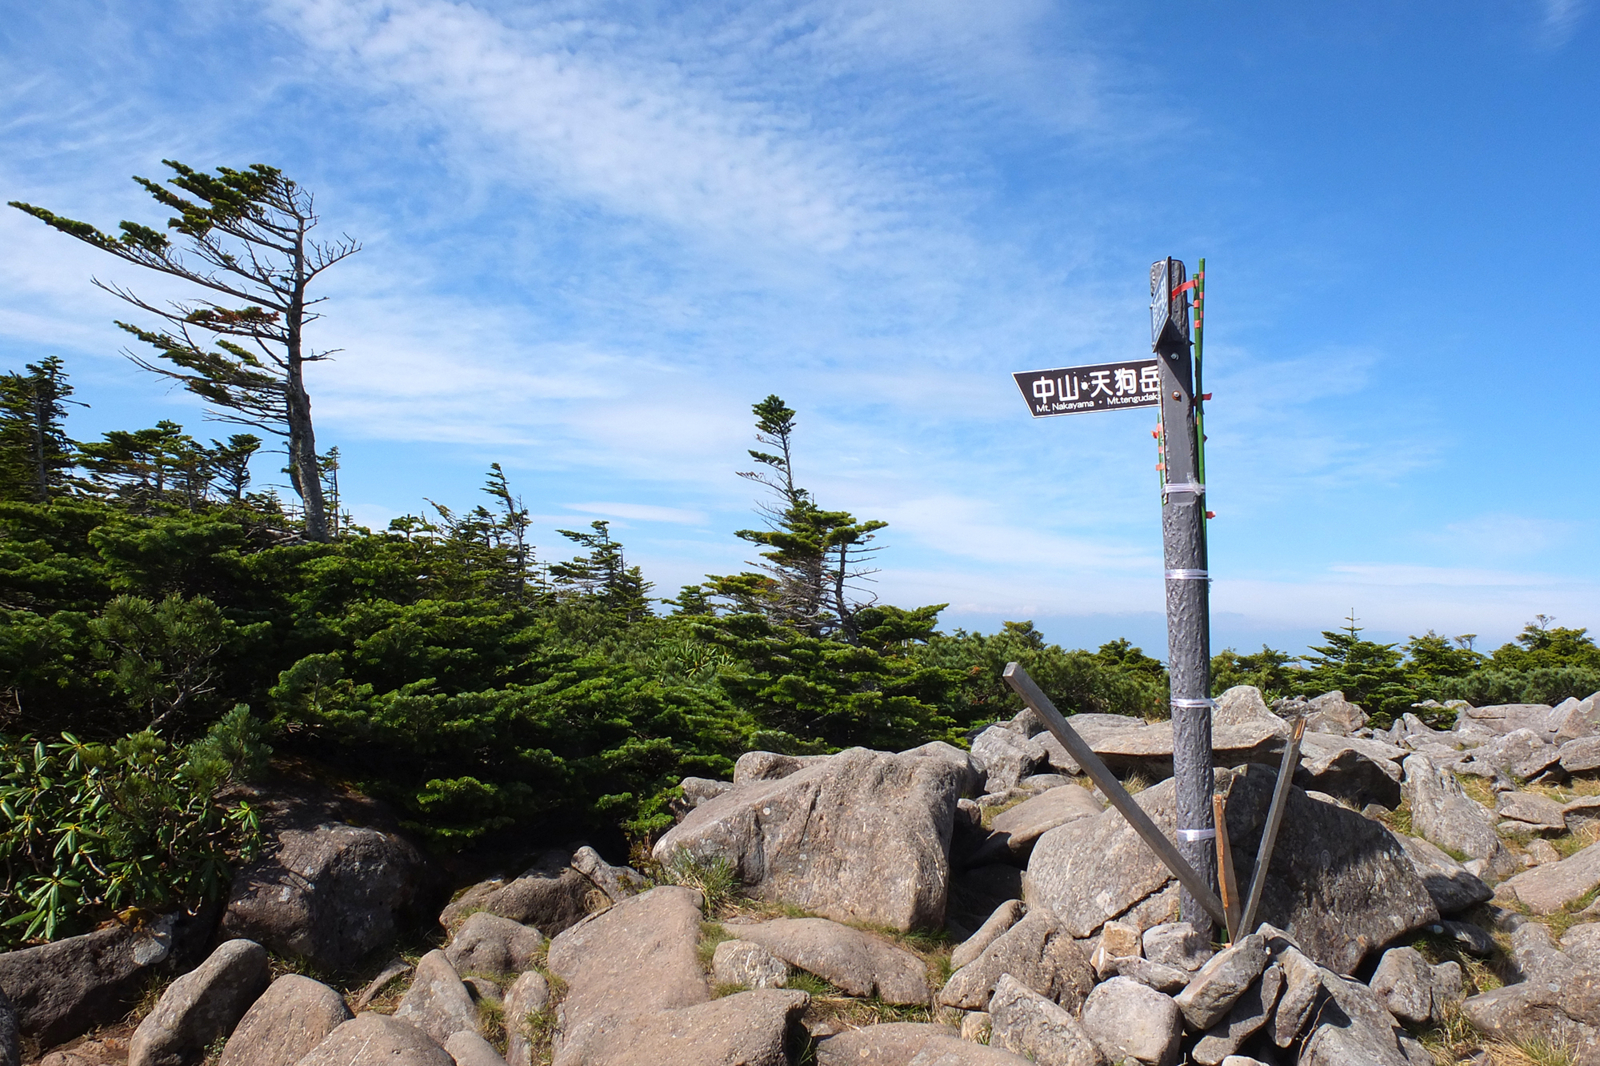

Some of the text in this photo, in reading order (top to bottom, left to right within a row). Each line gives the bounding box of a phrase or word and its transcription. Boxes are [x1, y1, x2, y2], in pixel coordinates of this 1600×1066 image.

[1032, 365, 1160, 404] 中山・天狗岳
[1036, 404, 1051, 413] Mt.
[1052, 400, 1095, 411] Nakayama
